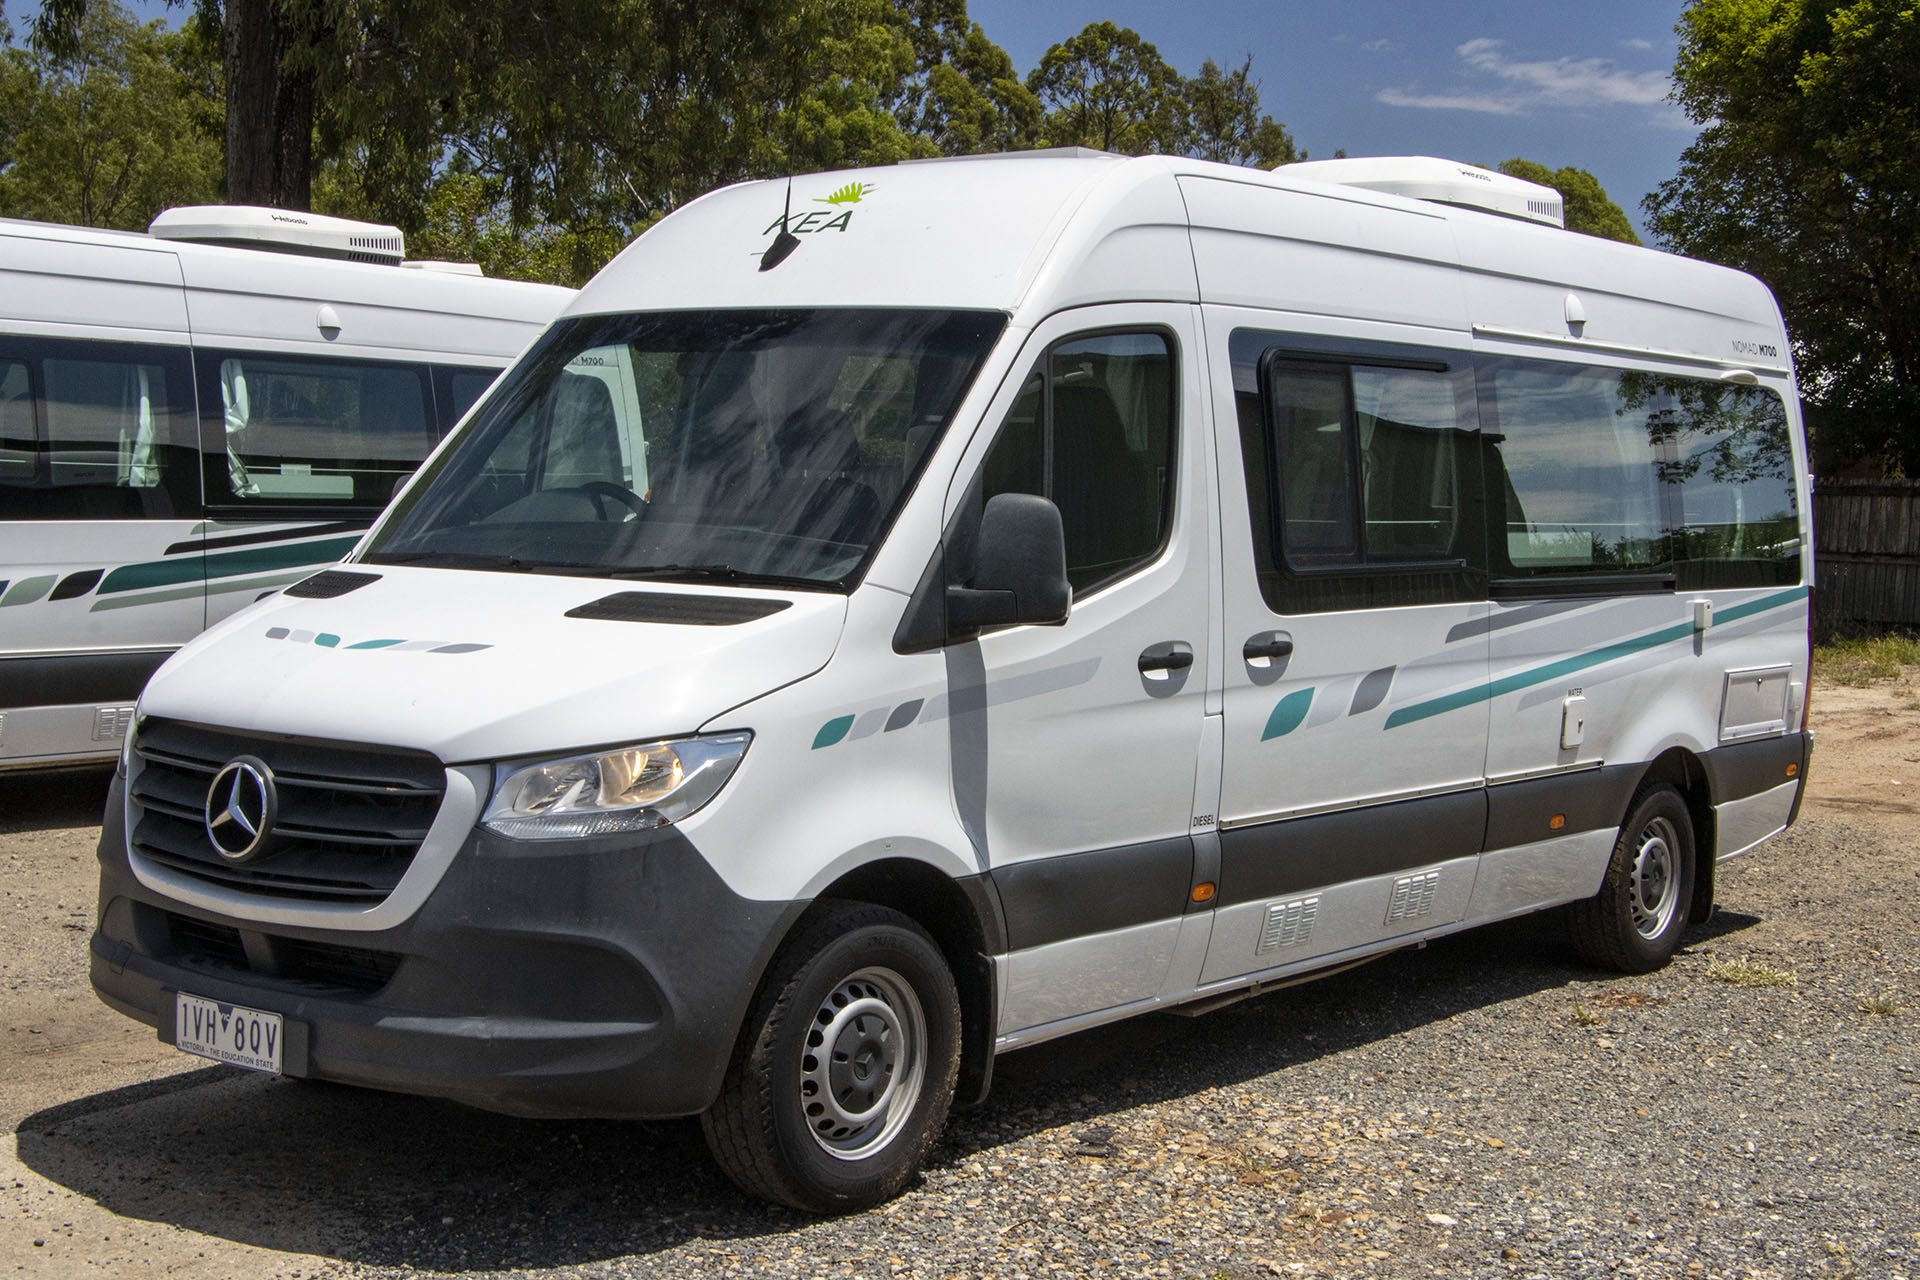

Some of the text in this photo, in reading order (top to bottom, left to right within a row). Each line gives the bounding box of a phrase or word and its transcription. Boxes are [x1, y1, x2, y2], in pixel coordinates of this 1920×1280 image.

[271, 214, 308, 226] Webasto
[762, 210, 853, 235] KEA
[1732, 340, 1777, 357] NOMAD M700
[580, 356, 605, 366] M700
[1568, 687, 1582, 697] WATER
[1193, 814, 1215, 827] DIESEL
[182, 1003, 277, 1058] 1VH 8QV
[181, 1040, 205, 1053] VICTORIA
[210, 1047, 220, 1057] THE
[221, 1050, 254, 1065] EDUCATION
[255, 1059, 274, 1070] STATE
